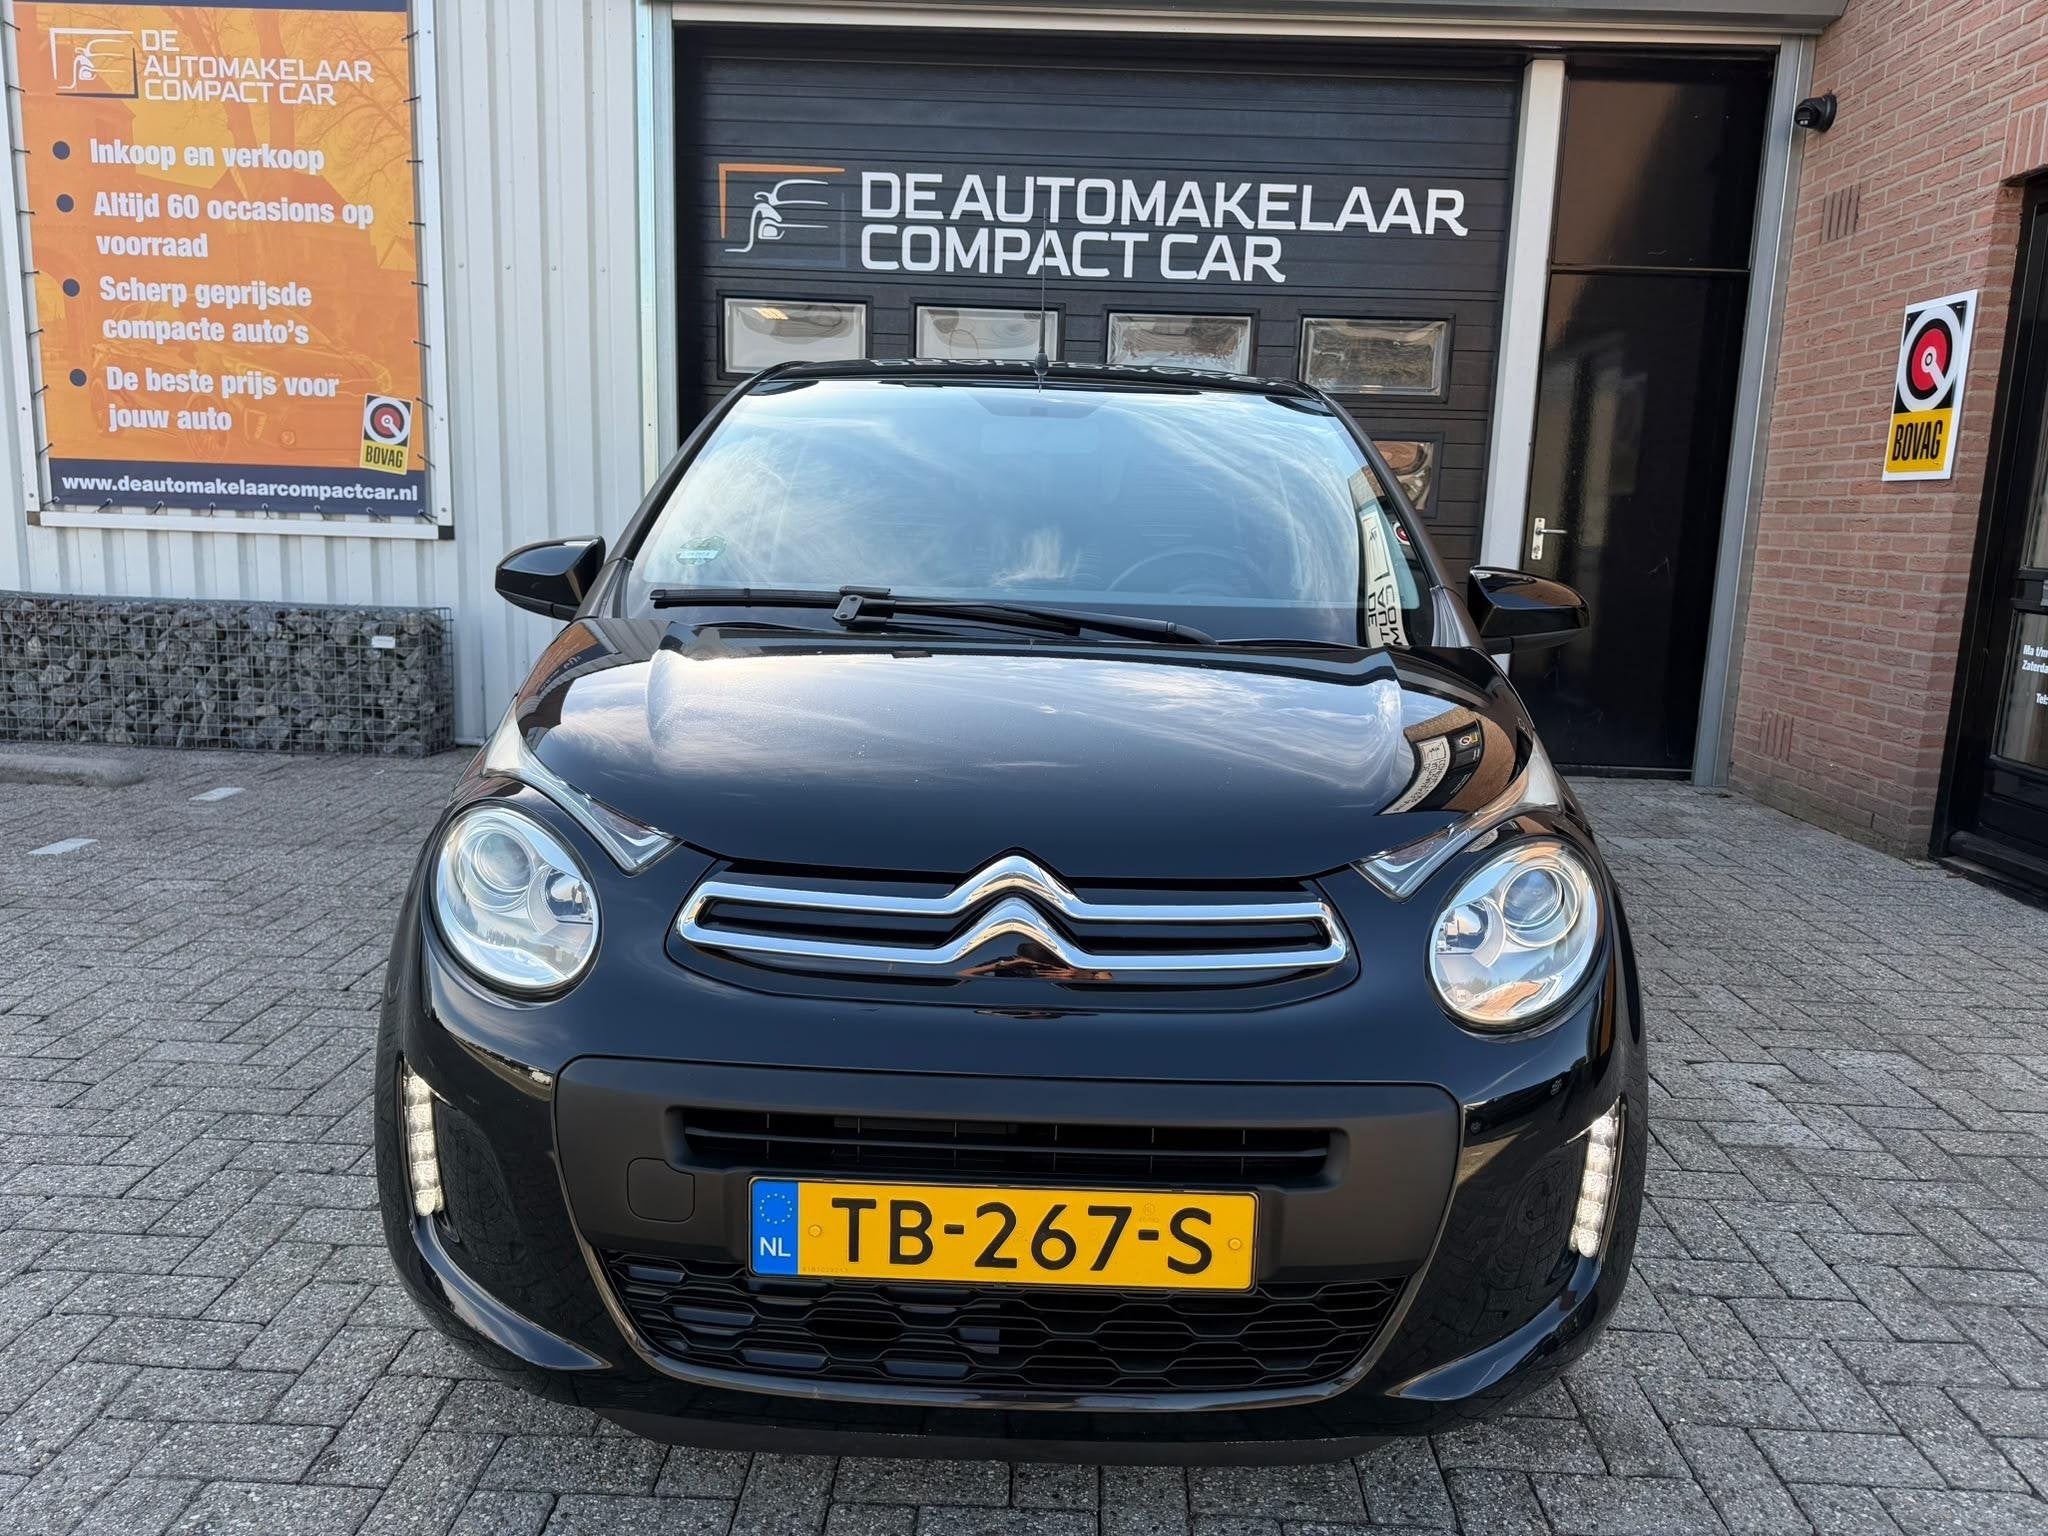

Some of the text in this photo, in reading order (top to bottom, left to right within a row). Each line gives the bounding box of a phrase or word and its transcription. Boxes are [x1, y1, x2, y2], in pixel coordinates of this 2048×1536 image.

[141, 30, 179, 52] DE
[144, 56, 375, 83] AUTOMAKELAAR
[144, 79, 337, 106] COMPACT CAR
[90, 138, 325, 176] Inkoop en verkoop
[94, 192, 375, 230] Altijd 60 occasions op
[862, 172, 1469, 238] DE AUTOMAKELAAR
[96, 233, 208, 258] voorraad
[860, 225, 1287, 285] COMPACT CAR
[100, 276, 312, 310] Scherp geprijsde
[103, 317, 309, 344] compacte auto's
[106, 367, 339, 399] De beste prijs voor
[109, 404, 232, 432] jouw auto
[1891, 420, 1943, 461] BOVAG
[365, 445, 404, 468] BOVAG
[62, 474, 418, 501] www.deautomakelaarcompactcar.nl
[2023, 644, 2034, 656] Ma
[760, 1237, 791, 1258] NL
[831, 1197, 1213, 1275] TB-267-S
